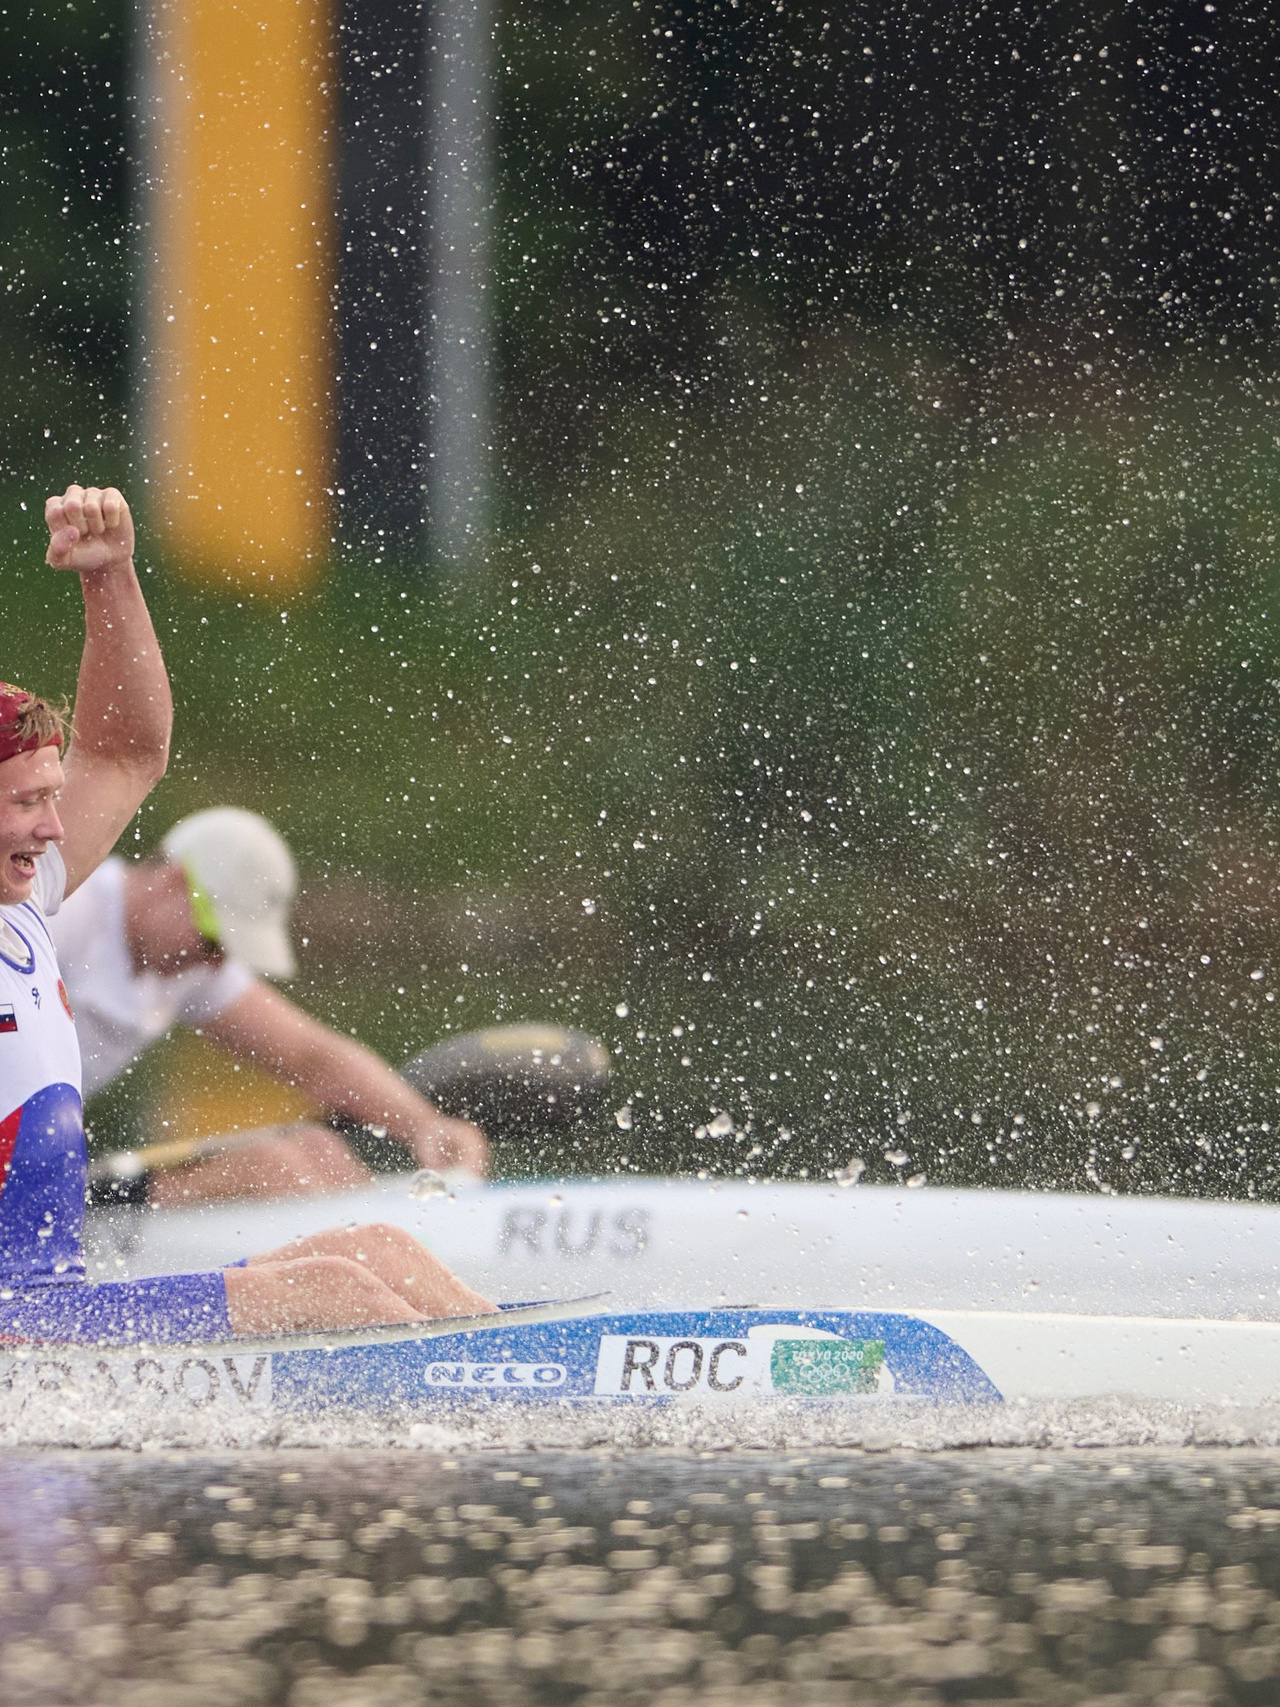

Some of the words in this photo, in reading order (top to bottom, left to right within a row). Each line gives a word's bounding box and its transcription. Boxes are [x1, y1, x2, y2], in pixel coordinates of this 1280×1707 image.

[496, 1207, 652, 1257] RUS
[620, 1339, 748, 1392] ROC
[791, 1350, 831, 1361] TOKYO
[832, 1350, 864, 1361] 2020
[431, 1365, 562, 1384] NELO
